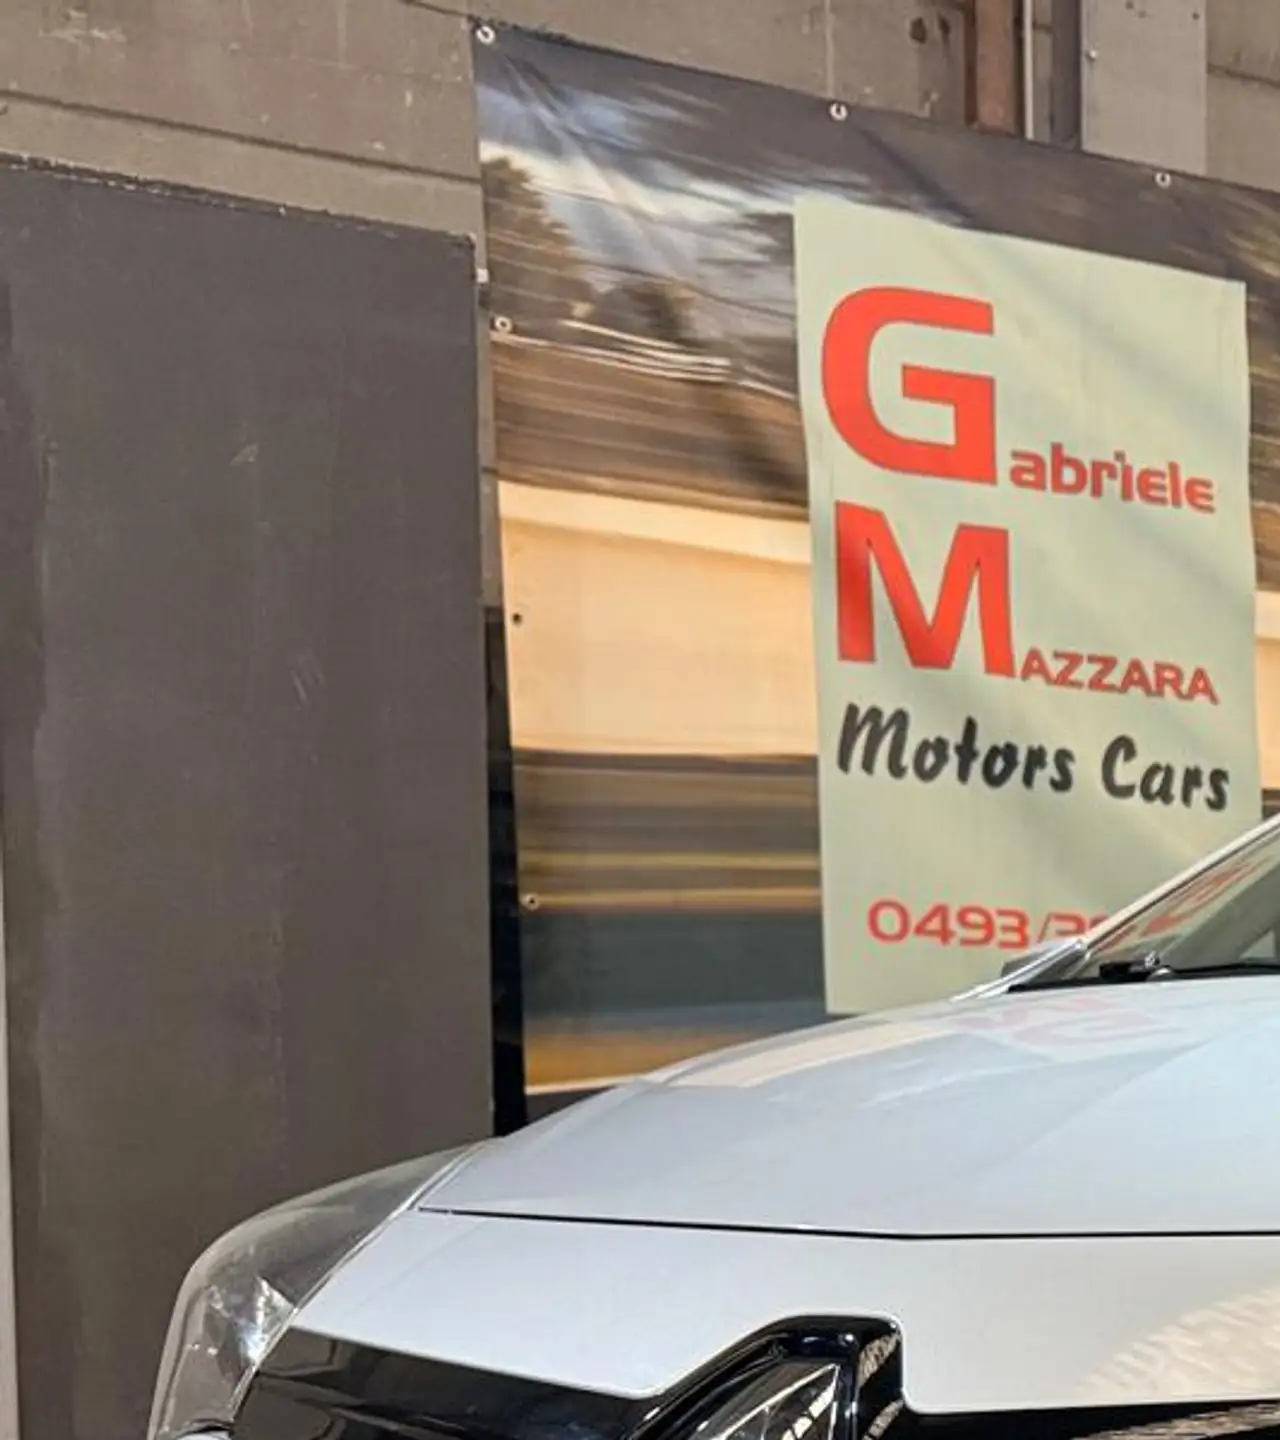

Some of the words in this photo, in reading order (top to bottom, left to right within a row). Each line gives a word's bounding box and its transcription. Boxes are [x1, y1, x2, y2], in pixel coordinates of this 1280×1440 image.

[821, 286, 1216, 512] Gabriele
[834, 500, 1219, 705] MAZZARA
[838, 701, 1074, 792] Motors
[1102, 734, 1230, 812] Cars
